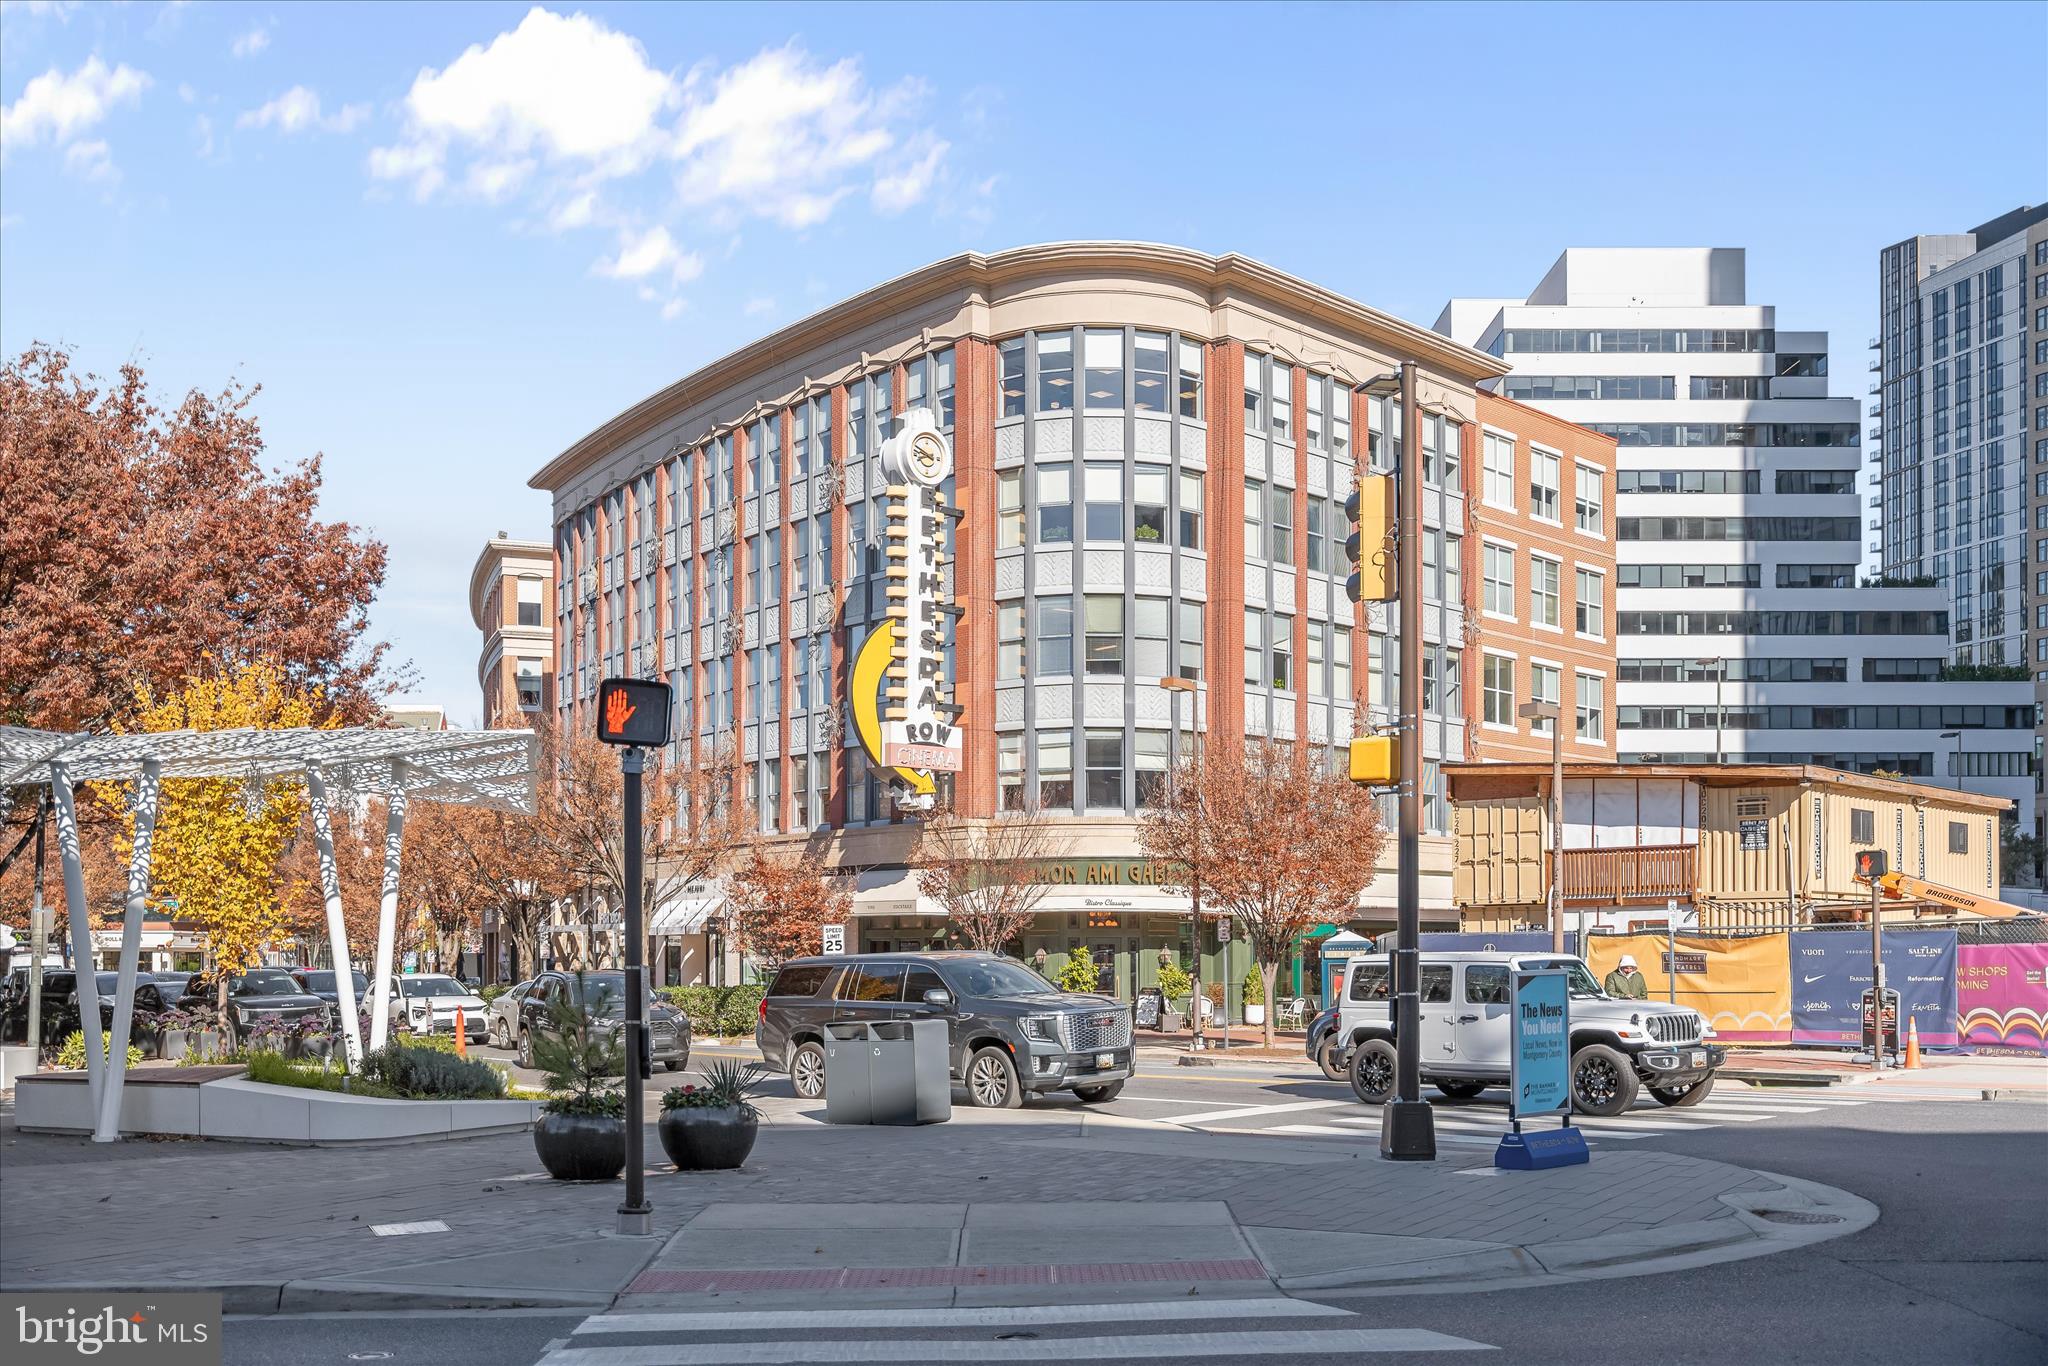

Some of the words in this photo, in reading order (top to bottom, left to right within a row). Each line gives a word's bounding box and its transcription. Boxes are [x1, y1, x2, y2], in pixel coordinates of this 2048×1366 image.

[917, 486, 940, 709] BETHESDA
[905, 722, 952, 745] ROW
[897, 748, 957, 768] CINEMA
[1035, 864, 1077, 885] MON
[1085, 863, 1122, 885] AMI
[825, 940, 843, 951] 25
[1968, 966, 2008, 977] SHOPS
[1521, 1003, 1538, 1018] The
[1540, 1002, 1563, 1017] News
[1521, 1020, 1538, 1036] You
[1540, 1017, 1563, 1035] Need
